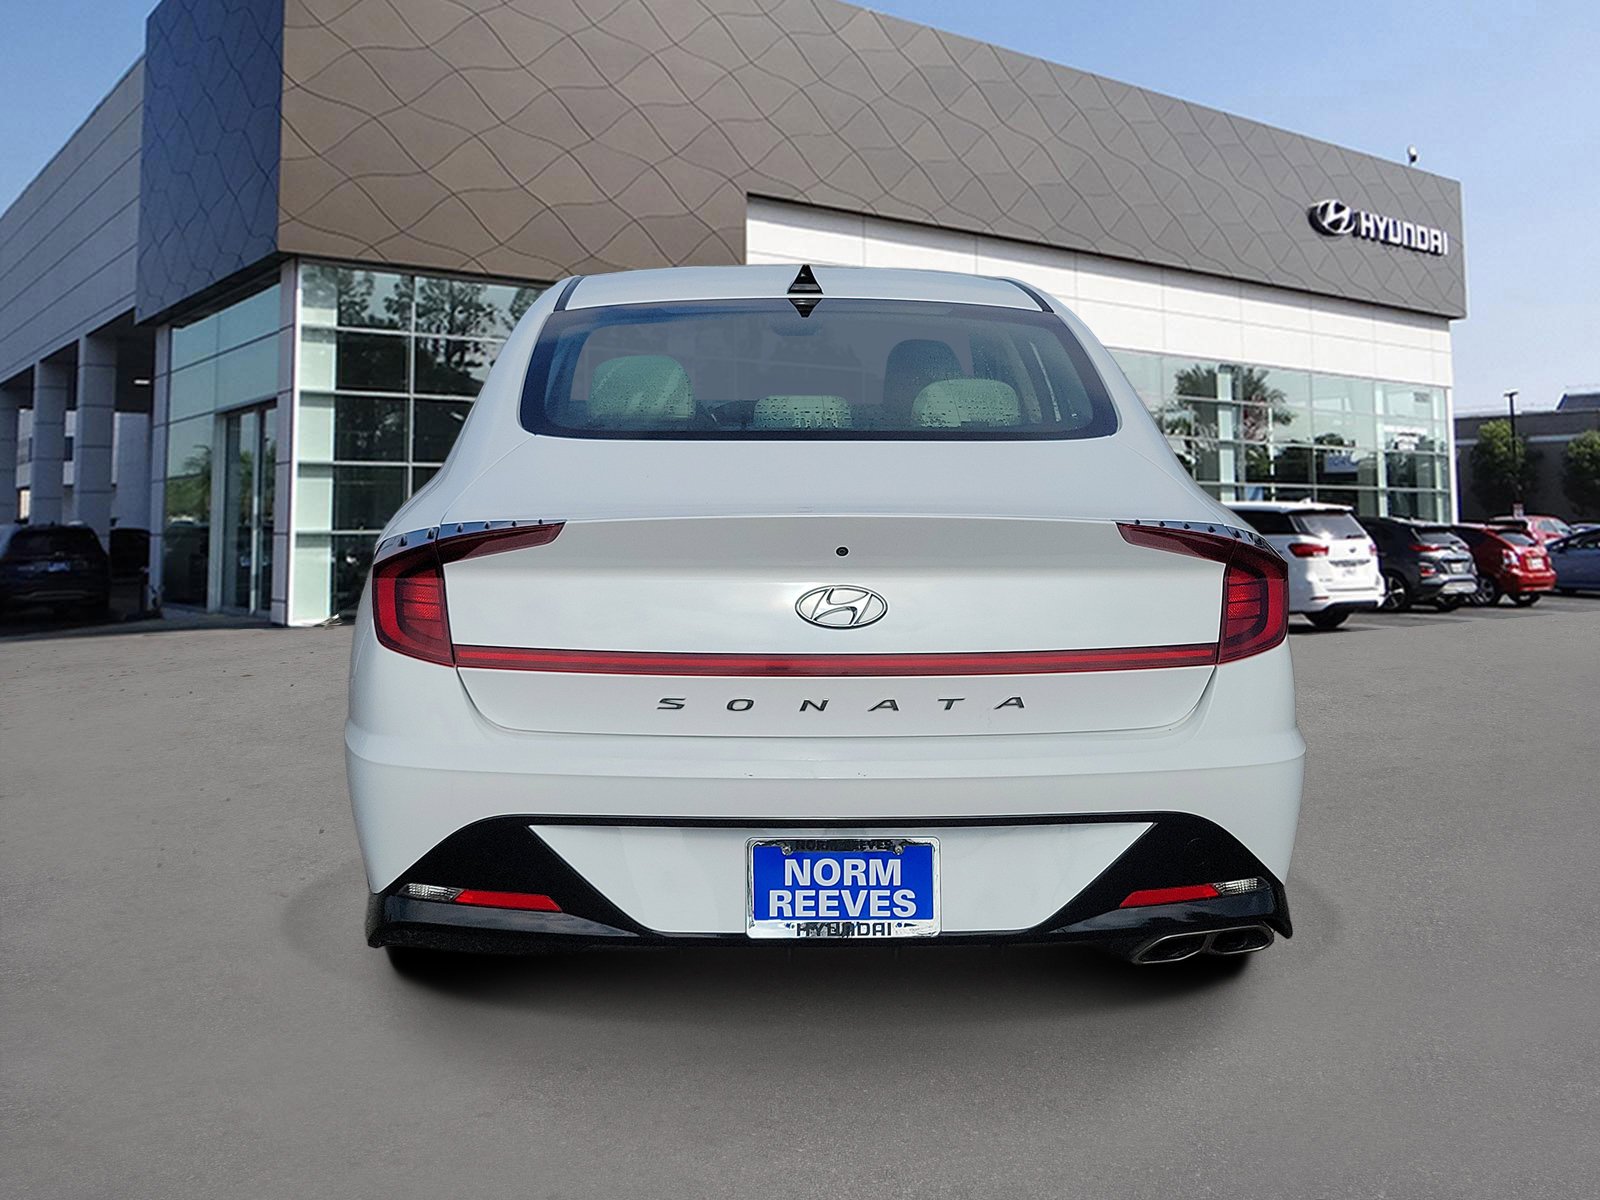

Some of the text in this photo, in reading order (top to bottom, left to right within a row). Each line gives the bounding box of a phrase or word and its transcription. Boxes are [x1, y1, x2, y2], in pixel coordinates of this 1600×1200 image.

[1360, 211, 1448, 255] HYUNDAI
[657, 696, 1025, 712] SONATA
[784, 858, 901, 887] NORM
[769, 889, 917, 918] REEVES
[796, 922, 892, 937] HYUNDAI
